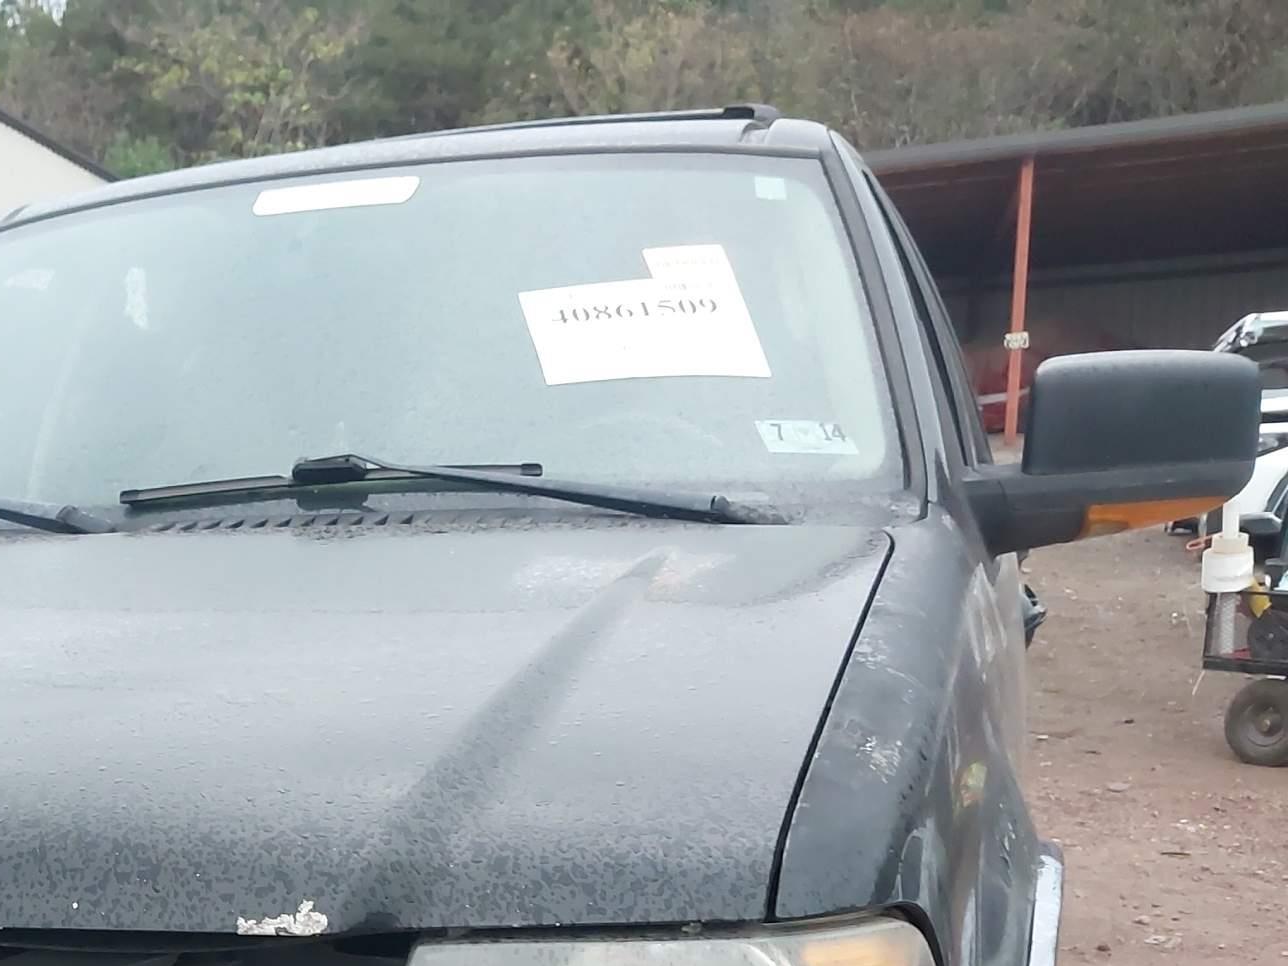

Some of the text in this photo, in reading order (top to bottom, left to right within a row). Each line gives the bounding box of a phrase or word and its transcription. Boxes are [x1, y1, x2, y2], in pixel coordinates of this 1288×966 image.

[550, 297, 719, 325] 40861509
[769, 421, 847, 443] 7 14
